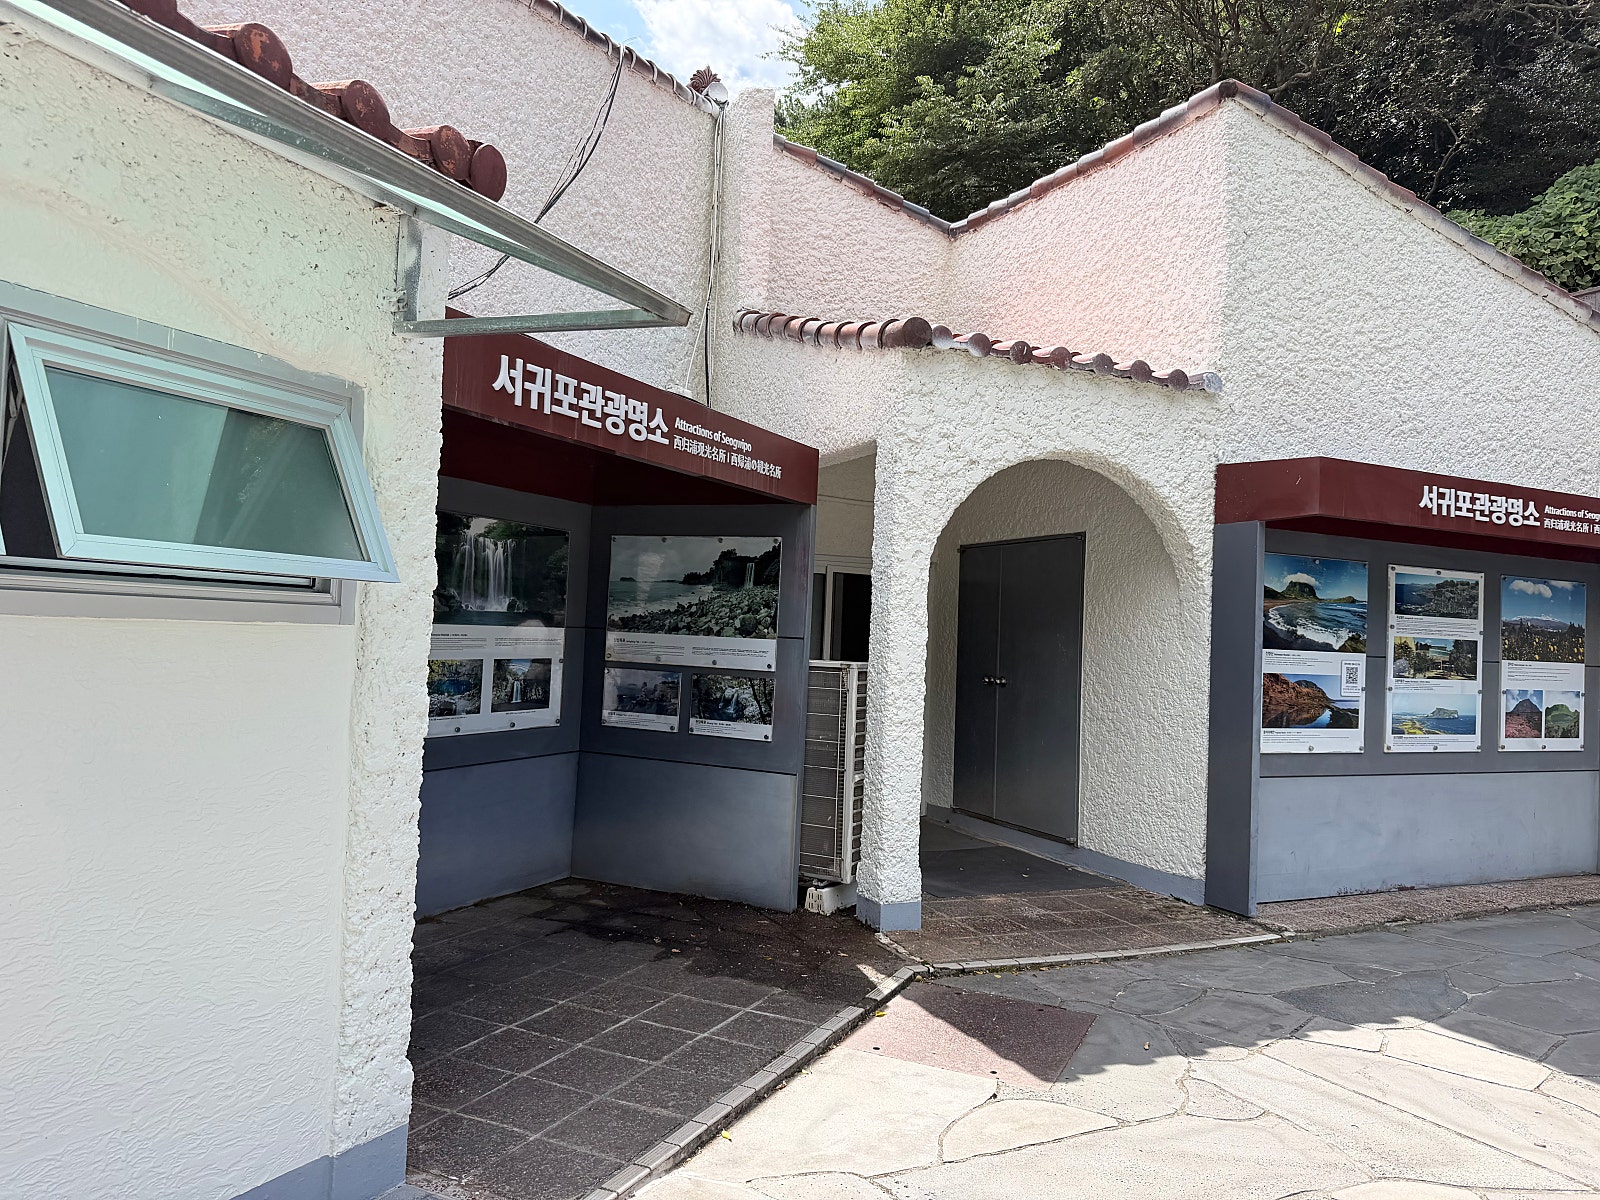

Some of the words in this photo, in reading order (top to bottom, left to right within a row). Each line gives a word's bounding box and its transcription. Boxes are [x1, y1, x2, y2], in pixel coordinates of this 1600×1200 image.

[491, 354, 670, 445] 서귀포관광명소
[675, 417, 713, 440] Attractions
[713, 430, 721, 443] of
[721, 432, 752, 453] Seogwipo
[1418, 485, 1541, 527] 서귀포관광명소
[1544, 505, 1577, 517] Attractions
[1577, 509, 1585, 518] of
